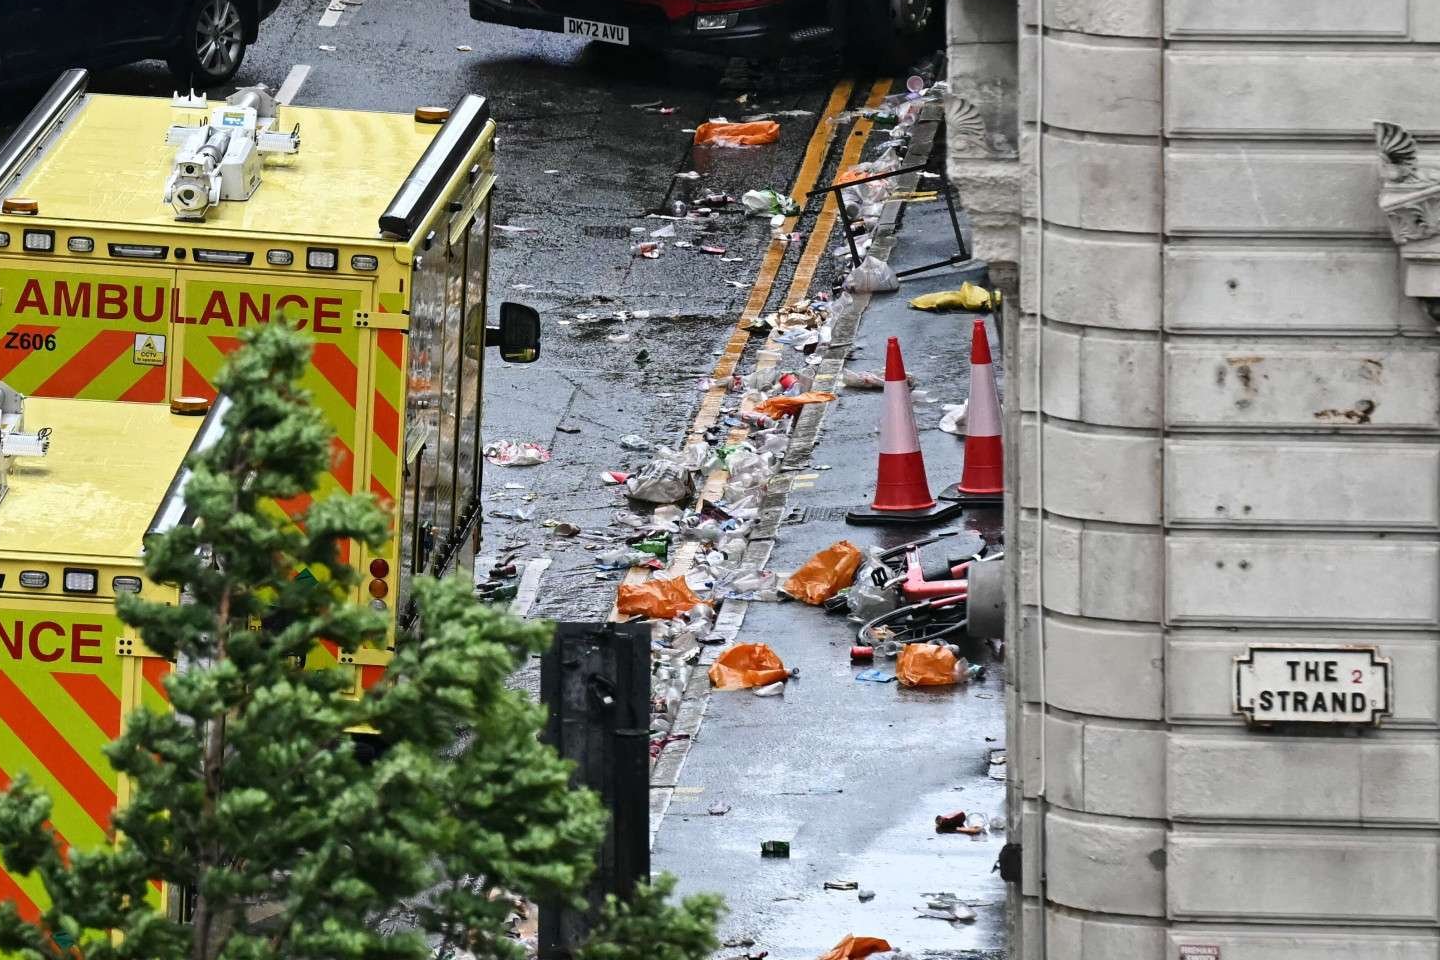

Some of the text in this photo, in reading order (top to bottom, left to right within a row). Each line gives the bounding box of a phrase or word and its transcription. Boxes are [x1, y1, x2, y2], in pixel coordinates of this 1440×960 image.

[569, 19, 624, 41] DK72 AVU
[14, 279, 343, 334] AMBULANCE
[5, 332, 57, 352] Z606
[1286, 661, 1363, 684] THE 2
[1259, 690, 1367, 713] STRAND
